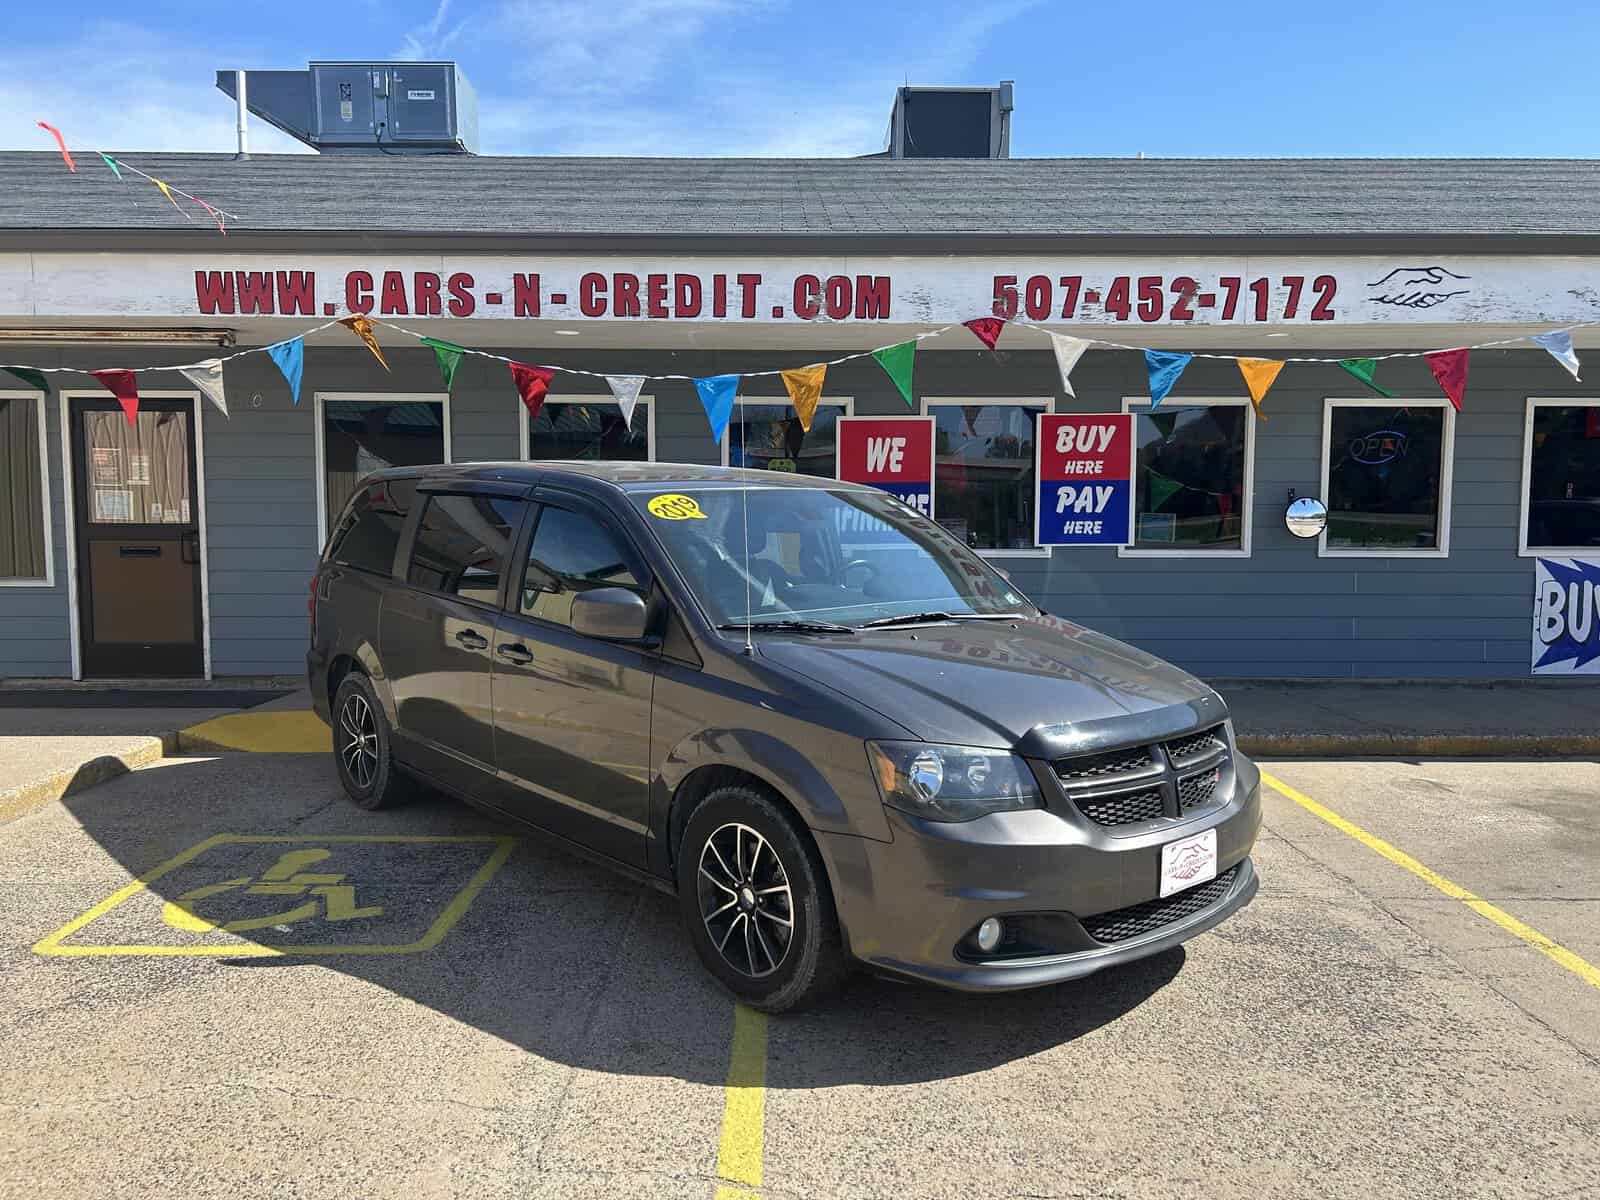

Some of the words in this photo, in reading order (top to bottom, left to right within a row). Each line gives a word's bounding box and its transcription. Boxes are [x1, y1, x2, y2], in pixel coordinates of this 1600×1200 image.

[993, 275, 1338, 322] 507-452-7172
[1055, 424, 1116, 455] BUY
[1351, 438, 1408, 457] OPEN
[866, 437, 906, 473] WE
[1064, 460, 1105, 475] HERE
[654, 497, 697, 519] 2019
[1055, 485, 1115, 514] PAY
[1063, 520, 1104, 536] HERE
